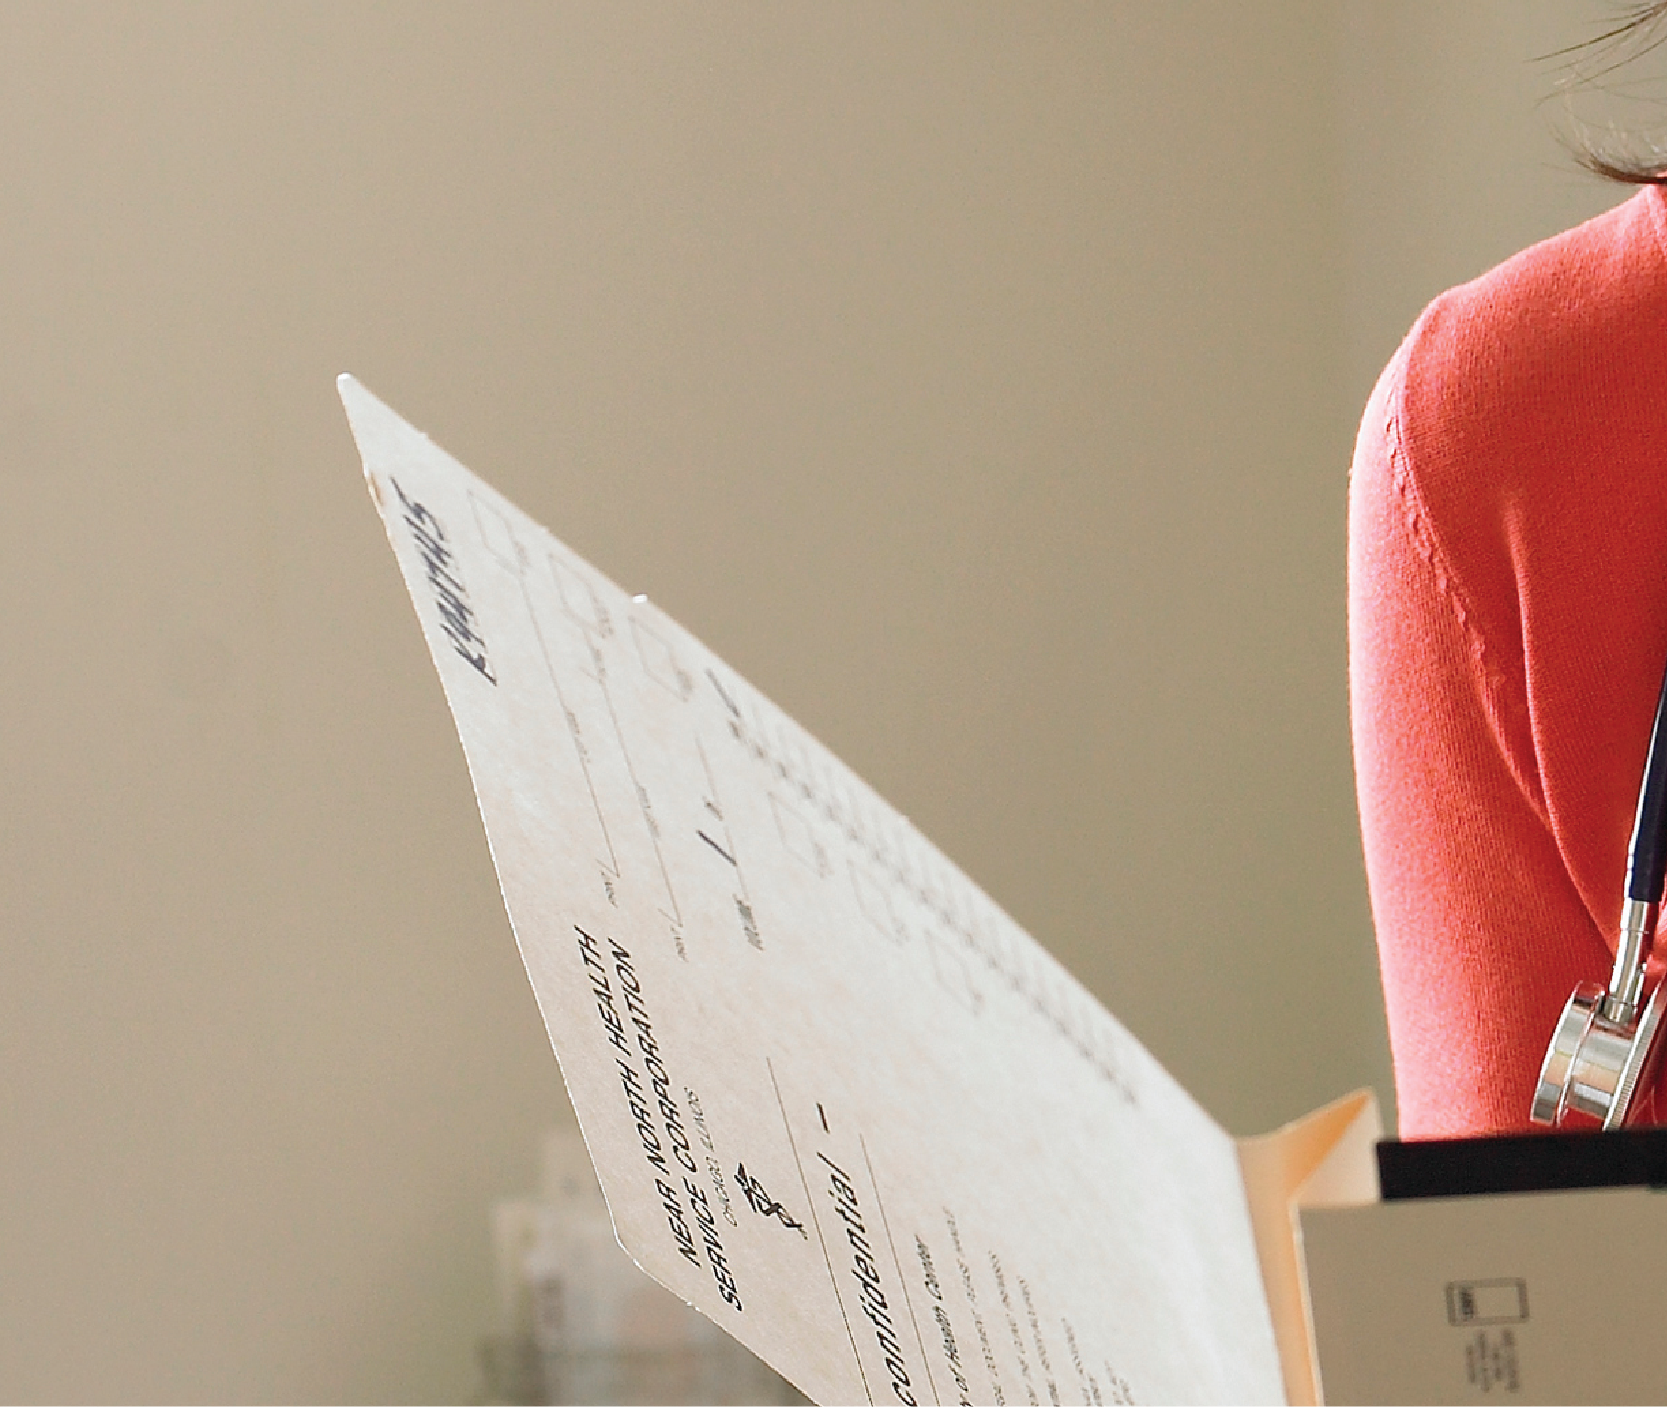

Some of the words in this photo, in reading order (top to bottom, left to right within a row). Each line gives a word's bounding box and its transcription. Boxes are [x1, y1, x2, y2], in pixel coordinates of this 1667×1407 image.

[574, 924, 632, 1057] HEALTH
[608, 936, 699, 1173] CORPORATION
[615, 1058, 671, 1176] NORTH
[655, 1178, 701, 1267] NEAR
[682, 1176, 743, 1312] SERVICE
[817, 1151, 918, 1406] confidential
